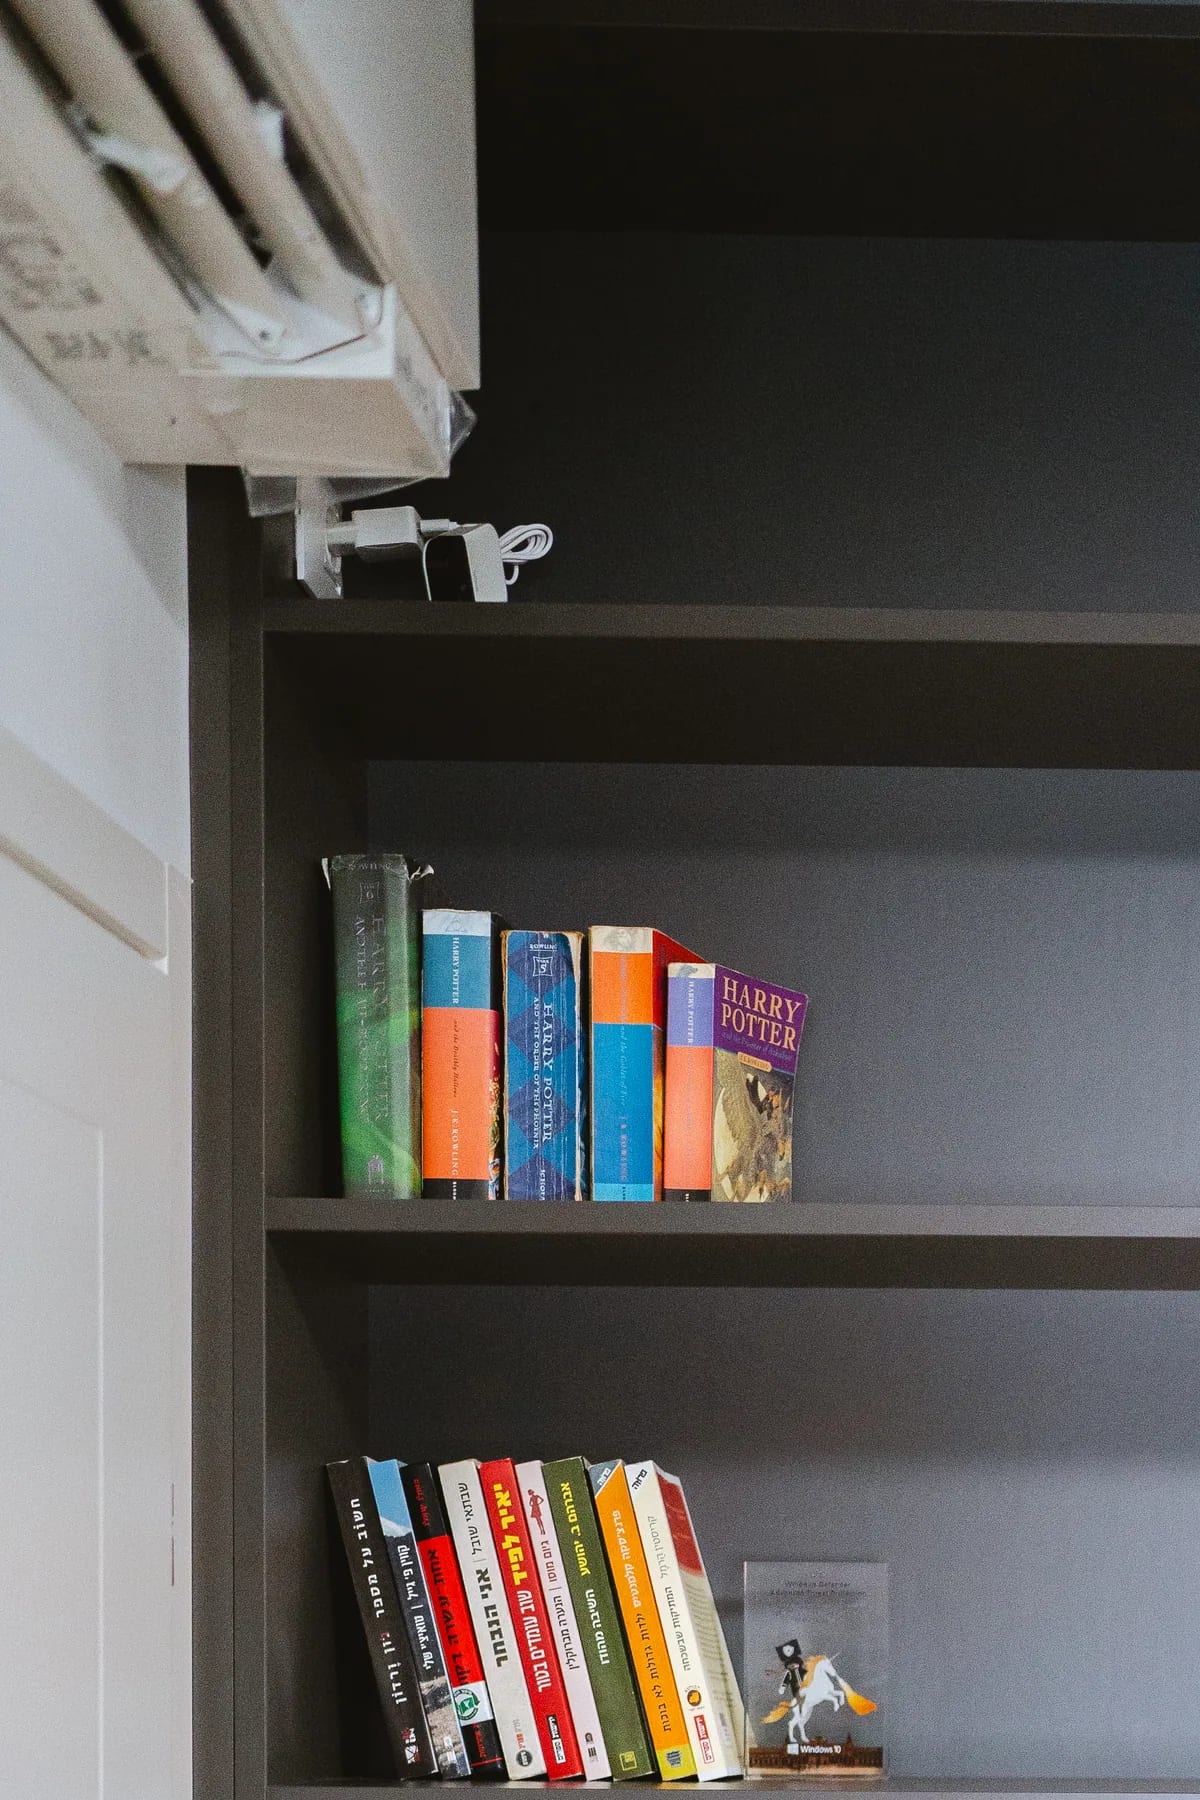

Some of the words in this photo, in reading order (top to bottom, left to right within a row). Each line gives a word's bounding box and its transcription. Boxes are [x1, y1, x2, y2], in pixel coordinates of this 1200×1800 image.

[451, 937, 459, 967] HARRY
[451, 968, 459, 1004] POTTER
[723, 976, 801, 1024] HARRY
[531, 996, 539, 1016] AND
[541, 1002, 553, 1070] HARRY
[686, 1011, 694, 1044] POTTER
[721, 1003, 796, 1051] POTTER
[532, 1041, 540, 1071] ORDER
[531, 1106, 540, 1149] PHOENIX
[542, 1077, 553, 1142] POTTER
[450, 1129, 459, 1175] ROWLING
[457, 1481, 476, 1522] שבתאי
[490, 1481, 517, 1530] יאיר
[559, 1481, 578, 1522] אברהם
[465, 1524, 483, 1554] שובל
[569, 1523, 581, 1537] ב.
[499, 1530, 529, 1586] לפיד
[540, 1539, 553, 1559] גיום
[573, 1539, 590, 1576] יהושע
[358, 1546, 374, 1567] על
[366, 1573, 386, 1618] מספר
[474, 1567, 493, 1599] אני
[545, 1560, 557, 1582] מוסו
[516, 1587, 536, 1614] שוב
[552, 1594, 567, 1627] הנערה
[583, 1588, 602, 1628] השיבה
[483, 1603, 509, 1667] הנבחר
[522, 1614, 546, 1659] עומדים
[635, 1611, 651, 1641] ילדות
[663, 1585, 680, 1626] המתיקות
[673, 1630, 691, 1672] שבשכחה
[559, 1627, 579, 1670] מברוקלין
[593, 1630, 610, 1664] מהודו
[642, 1644, 659, 1680] גדולות
[532, 1660, 553, 1692] בטור
[651, 1683, 664, 1699] לא
[656, 1702, 672, 1732] בוכות
[800, 1745, 833, 1753] Windows
[834, 1745, 841, 1753] 10
